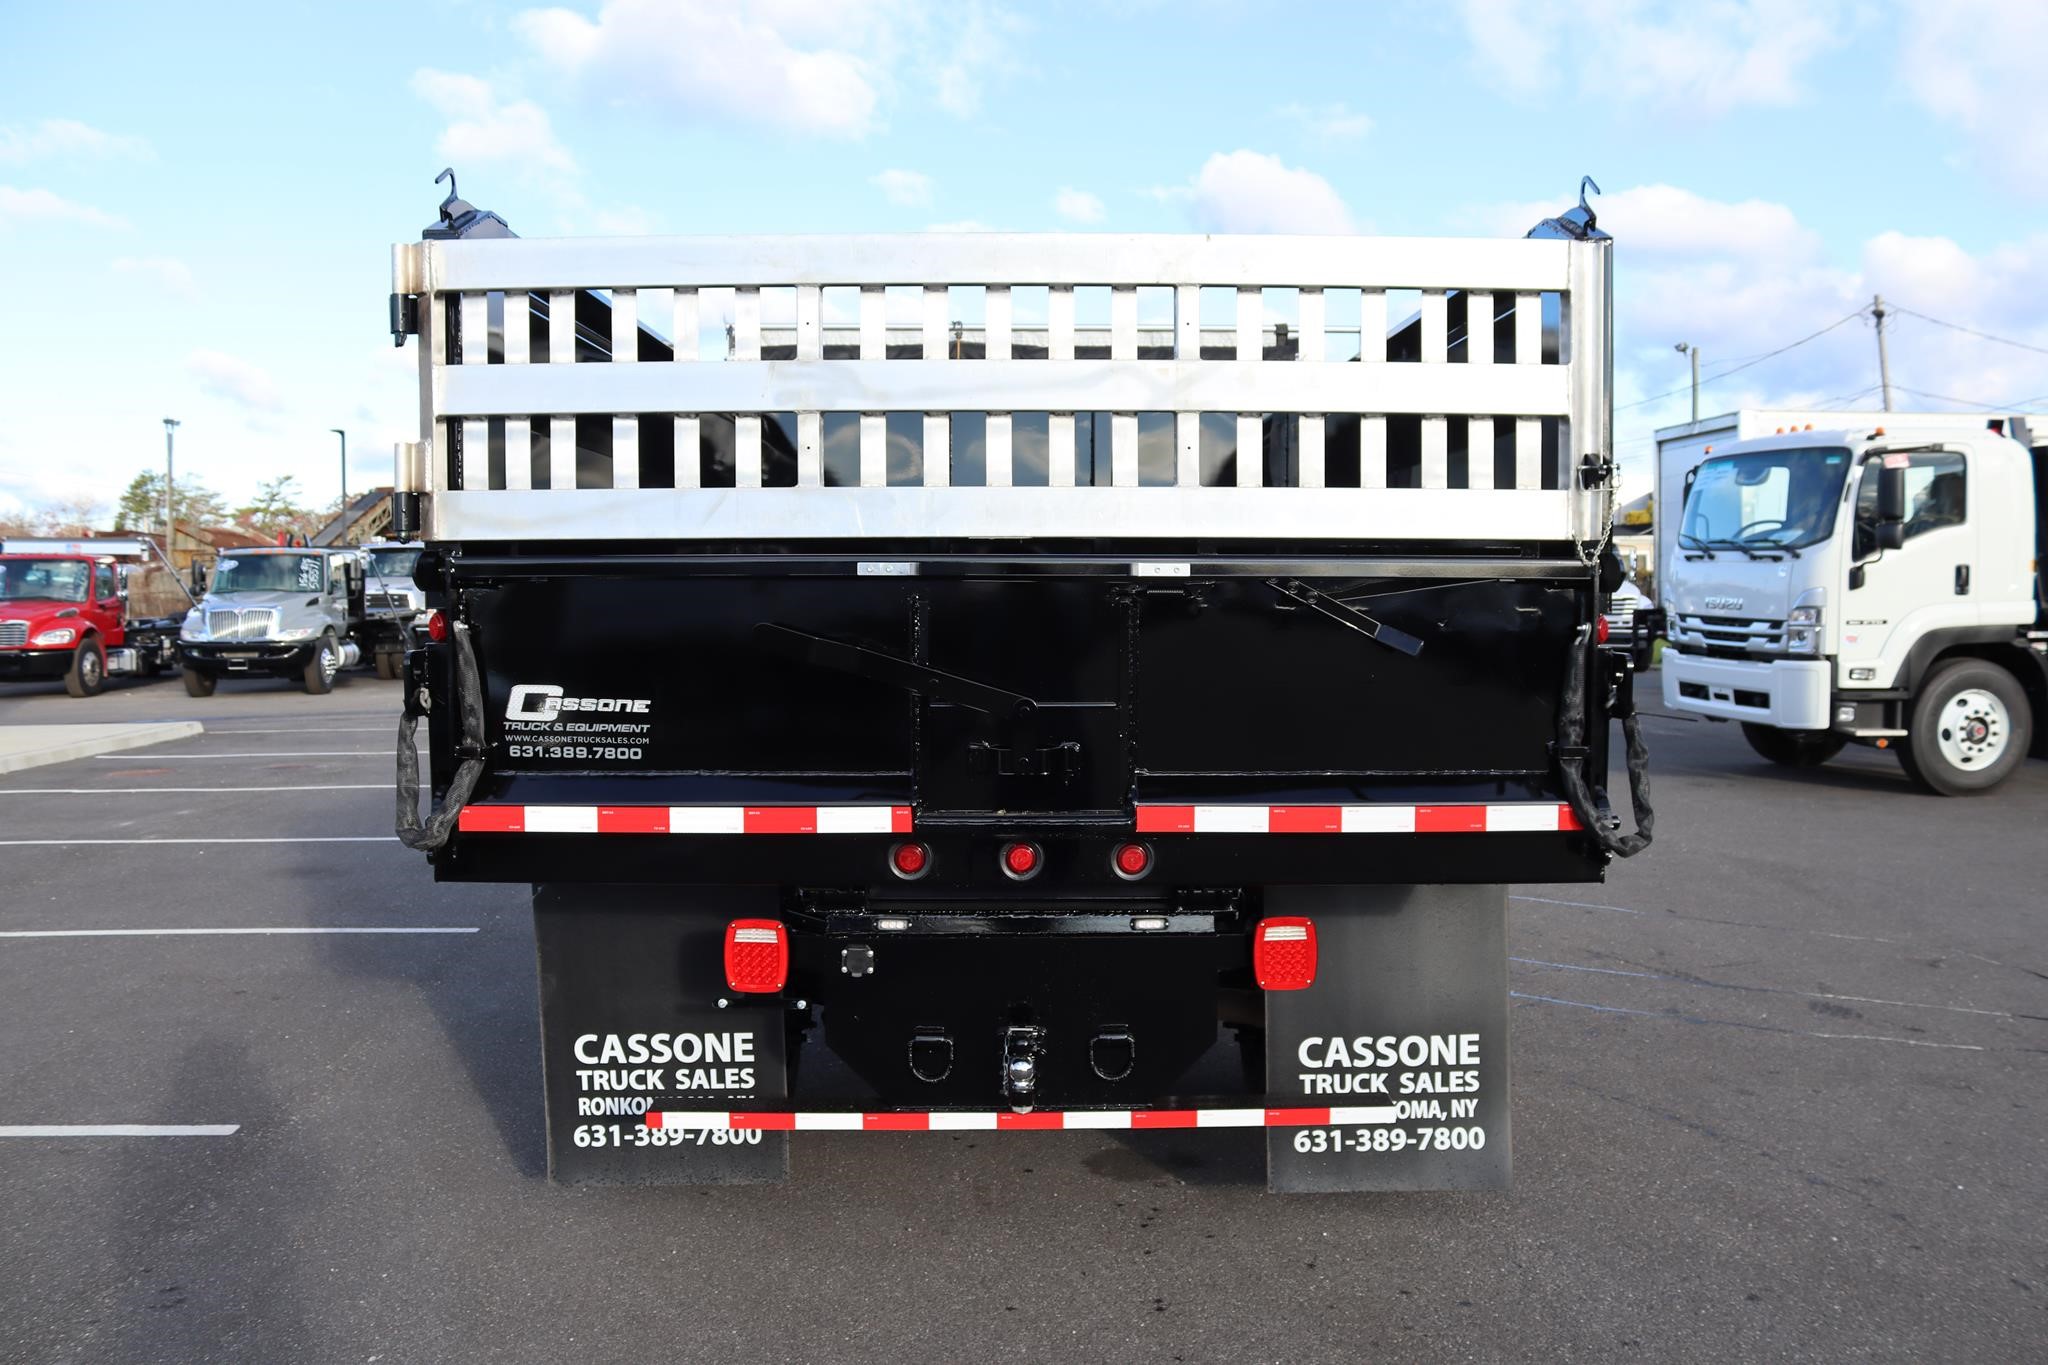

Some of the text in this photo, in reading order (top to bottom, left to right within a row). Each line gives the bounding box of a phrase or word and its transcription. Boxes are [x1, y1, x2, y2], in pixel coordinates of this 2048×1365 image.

[504, 722, 650, 733] TRUCK & EQUIPMENT
[505, 735, 650, 744] WWW.CASSONETRUCKSALES.COM
[509, 745, 642, 760] 631.389.7800
[574, 1032, 755, 1064] CASSONE
[1298, 1034, 1481, 1068] CASSONE
[576, 1068, 755, 1091] TRUCK SALES
[1299, 1071, 1480, 1094] TRUCK SALES
[1451, 1099, 1478, 1118] NY
[573, 1124, 762, 1147] 631-389-7800
[1294, 1126, 1486, 1153] 631-389-7800
